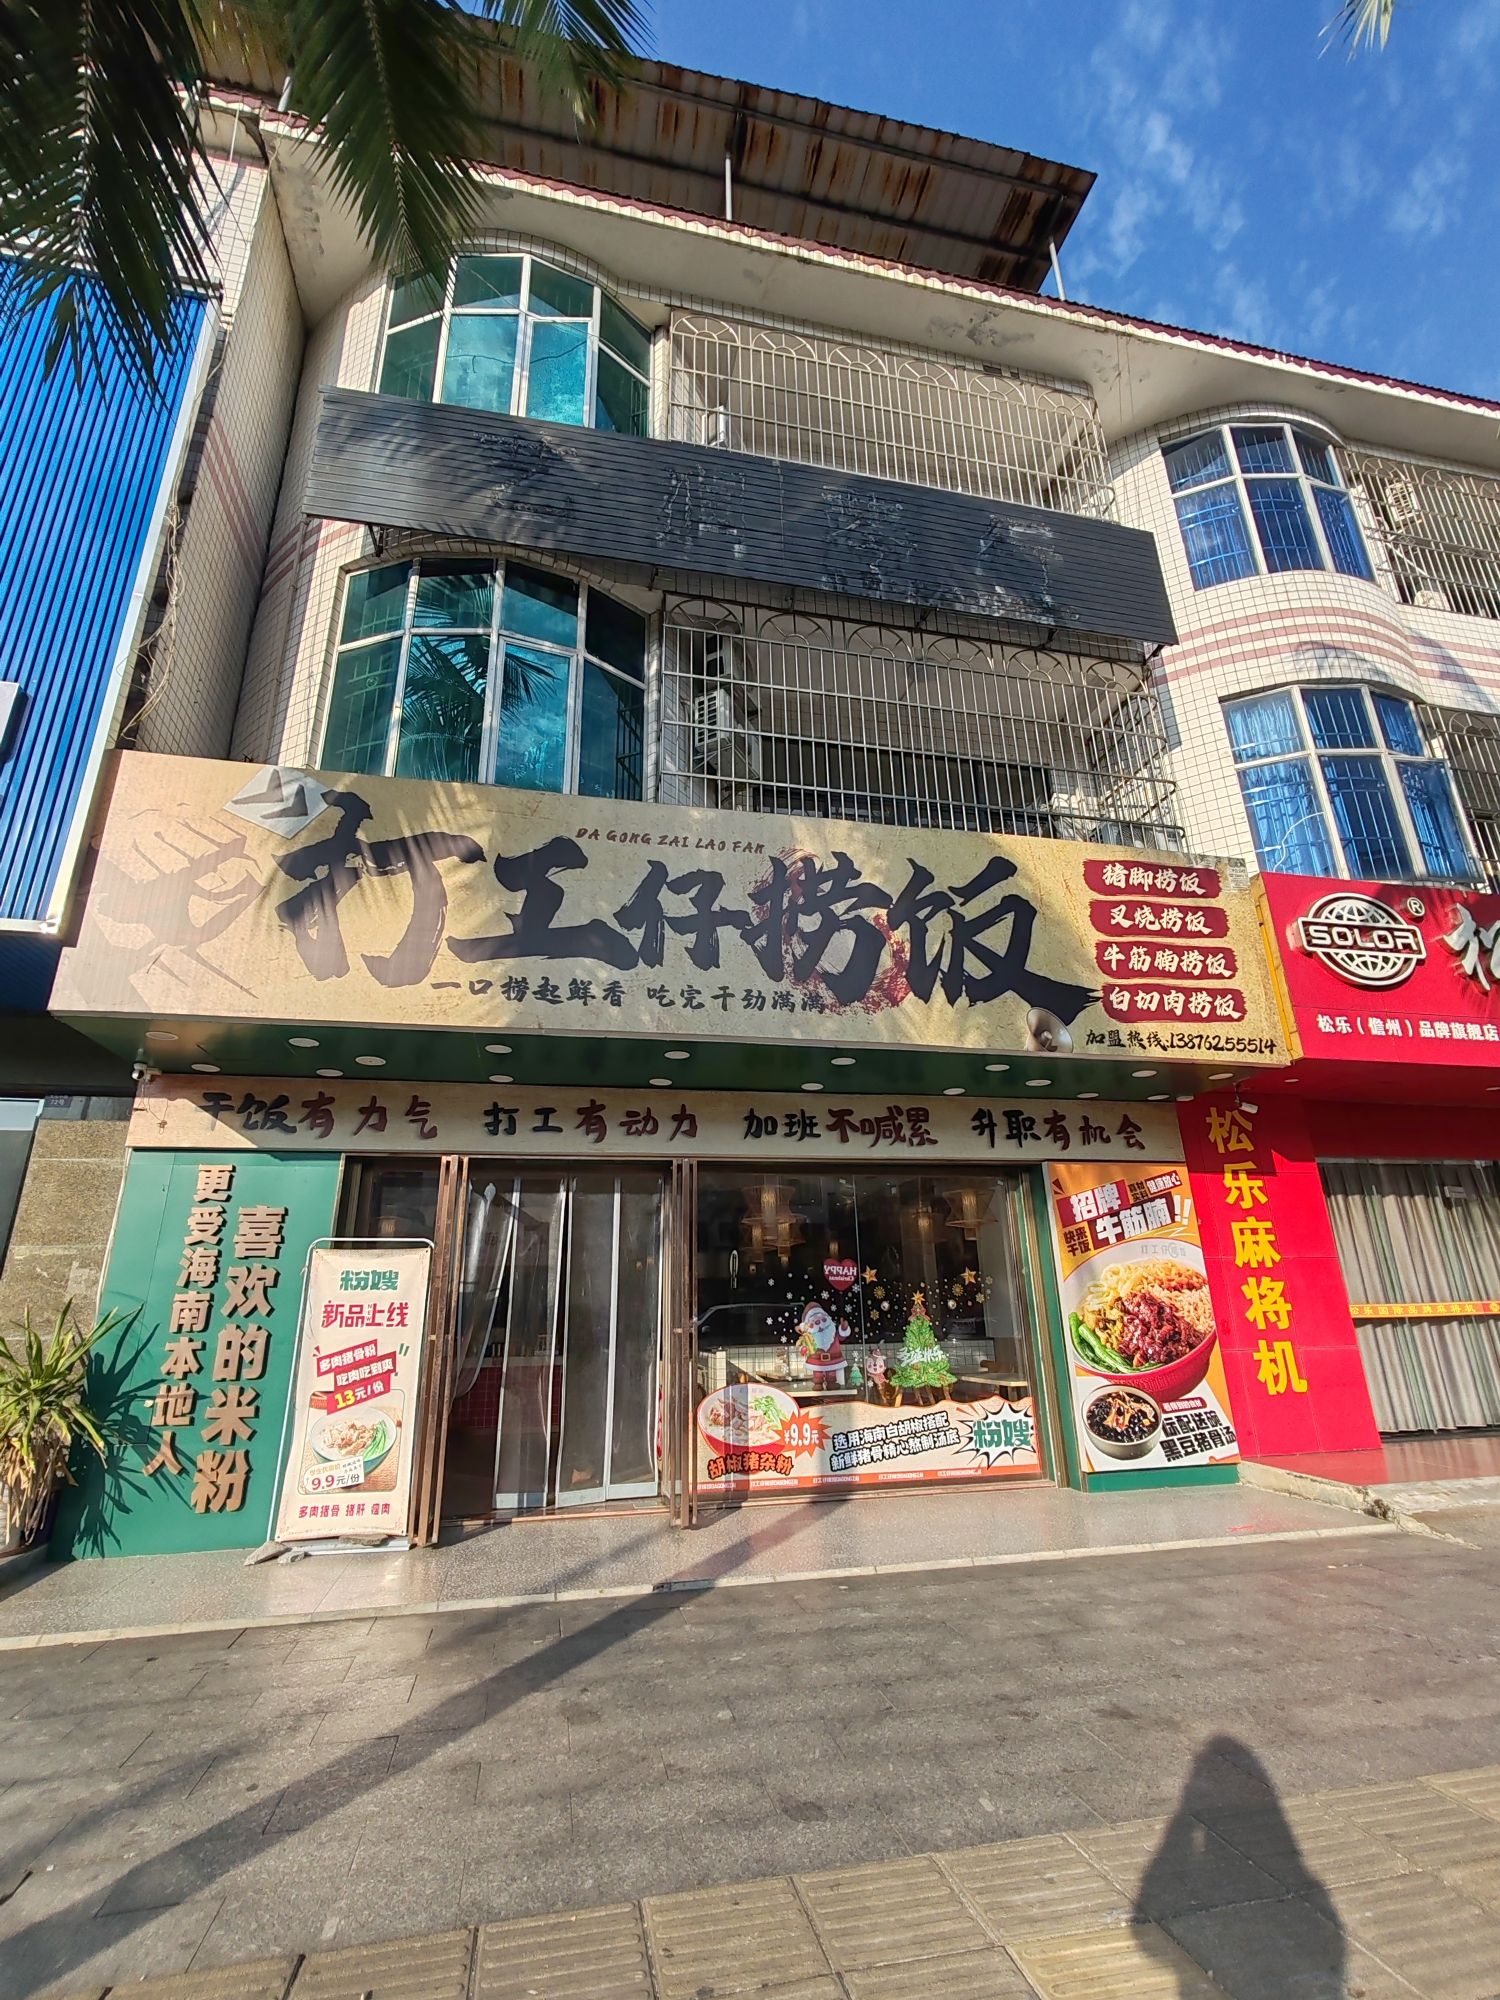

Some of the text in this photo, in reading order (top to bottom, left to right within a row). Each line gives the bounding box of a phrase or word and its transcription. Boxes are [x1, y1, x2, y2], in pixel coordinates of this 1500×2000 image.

[575, 828, 765, 854] DA GONG ZAI LAO FAN
[1102, 862, 1206, 895] 猪脚捞饭
[272, 790, 1103, 1027] 打工仔捞饭
[1110, 905, 1213, 935] 叉烧捞饭
[1103, 943, 1233, 978] 牛筋腩捞饭
[430, 975, 826, 1014] 一口捞起鲜香 吃完干劲满满
[1109, 987, 1243, 1019] 白切肉捞饭
[199, 1090, 1146, 1150] 干饭有力气 打工有动力 加班不喊累 升职有机会
[1070, 1183, 1121, 1222] 招牌
[1206, 1107, 1308, 1397] 松乐麻将机
[340, 1270, 399, 1291] 粉嫂
[143, 1164, 236, 1479] 更受海南本地人
[321, 1300, 409, 1328] 新品上线
[190, 1205, 288, 1514] 喜欢的米粉
[319, 1344, 377, 1373] 多肉猪骨粉
[336, 1358, 394, 1386] 吃肉吃到爽
[334, 1382, 384, 1409] 13元/份
[832, 1411, 950, 1451] 选用海南白胡椒搭配
[973, 1419, 1030, 1448] 粉嫂
[1160, 1426, 1236, 1462] 黑豆猪骨汤
[708, 1453, 794, 1480] 胡椒猪杂粉
[830, 1428, 961, 1472] 新鲜猪骨精心熬制汤底
[312, 1473, 360, 1491] 9.9元/份
